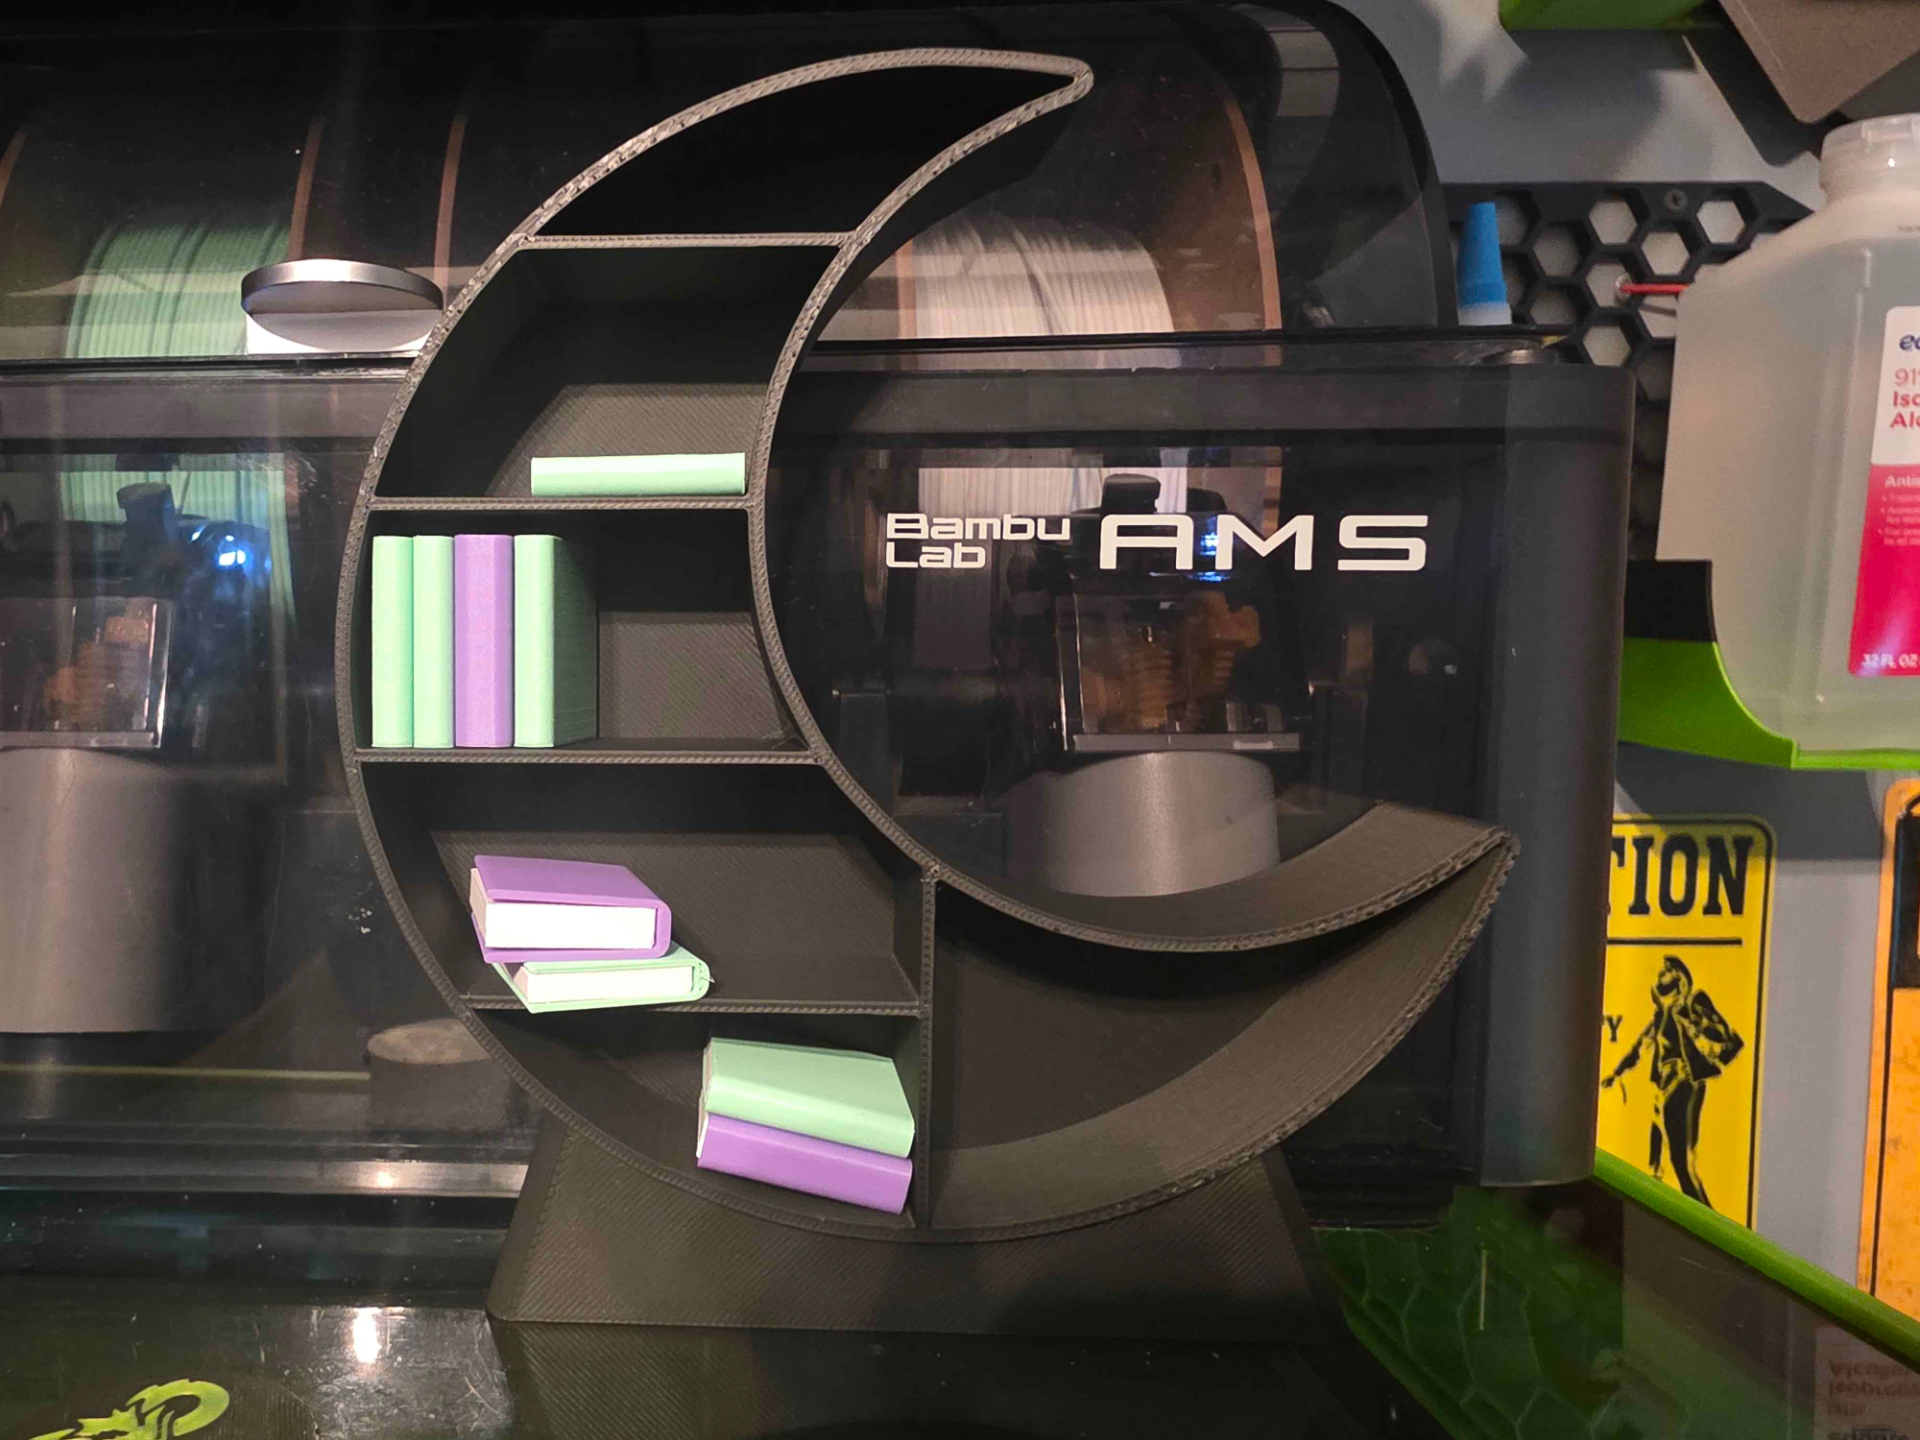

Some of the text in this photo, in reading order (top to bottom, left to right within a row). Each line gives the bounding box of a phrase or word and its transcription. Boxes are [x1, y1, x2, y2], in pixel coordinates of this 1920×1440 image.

[1894, 368, 1920, 387] 91
[886, 513, 1070, 540] Bambu
[886, 541, 986, 568] Lab
[1100, 514, 1429, 571] AMS
